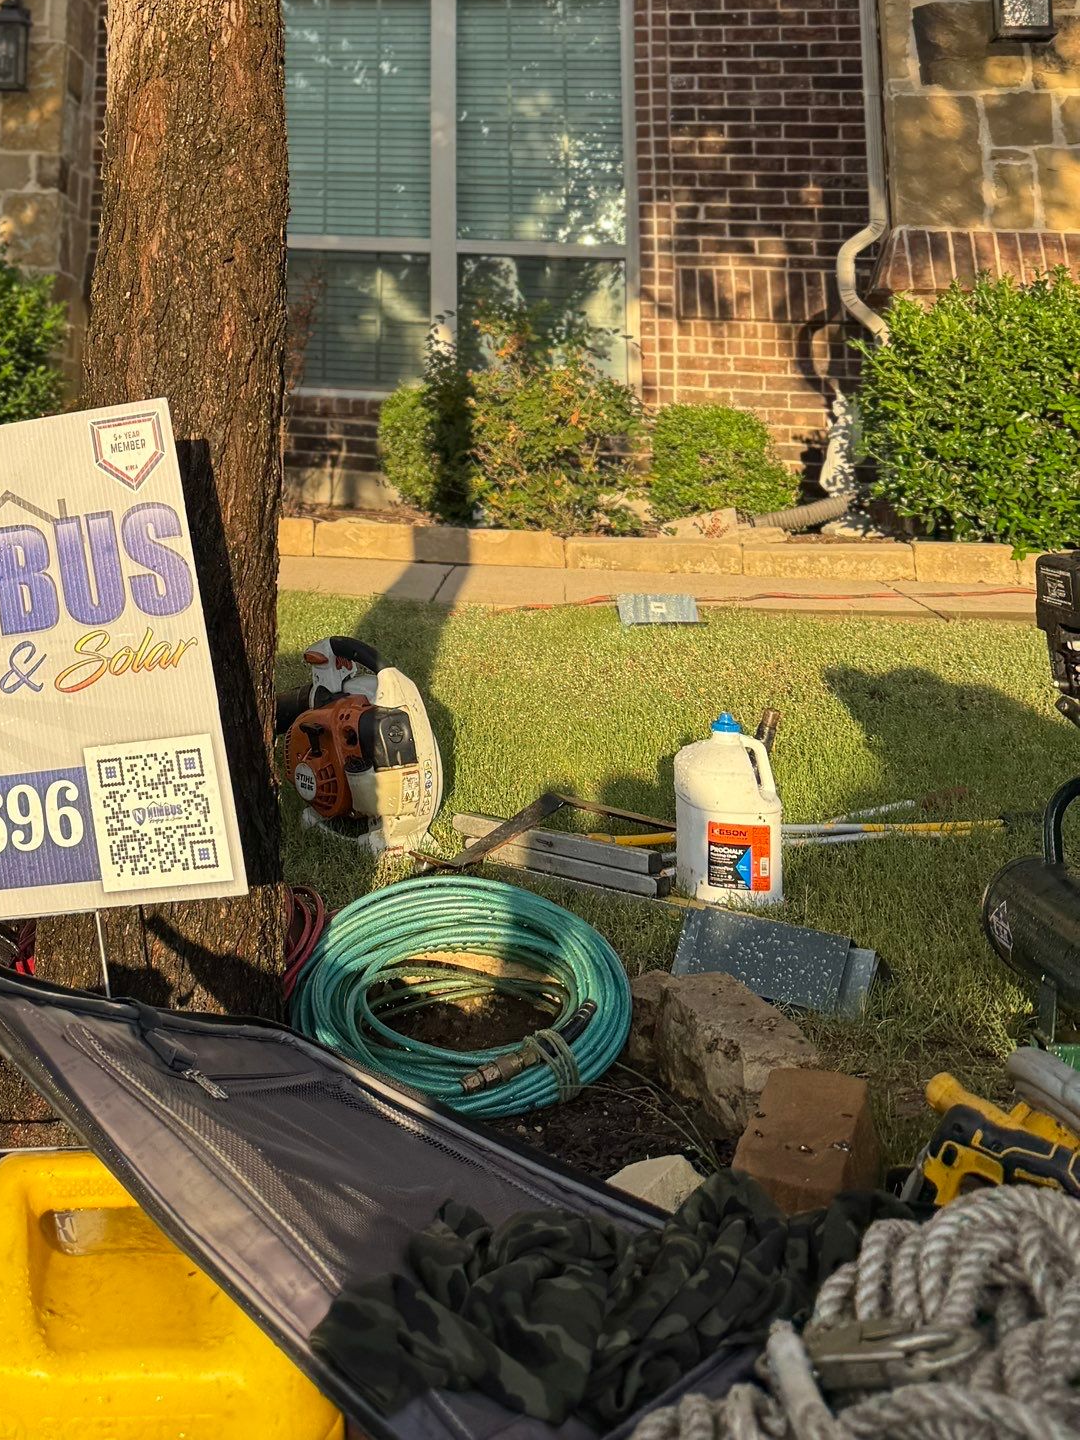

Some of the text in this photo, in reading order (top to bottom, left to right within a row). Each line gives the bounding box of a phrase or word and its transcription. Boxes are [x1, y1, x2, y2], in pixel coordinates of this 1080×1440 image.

[124, 430, 140, 440] YEAR
[110, 438, 146, 454] MEMBER
[54, 626, 199, 694] Solar
[296, 772, 315, 785] STIHL
